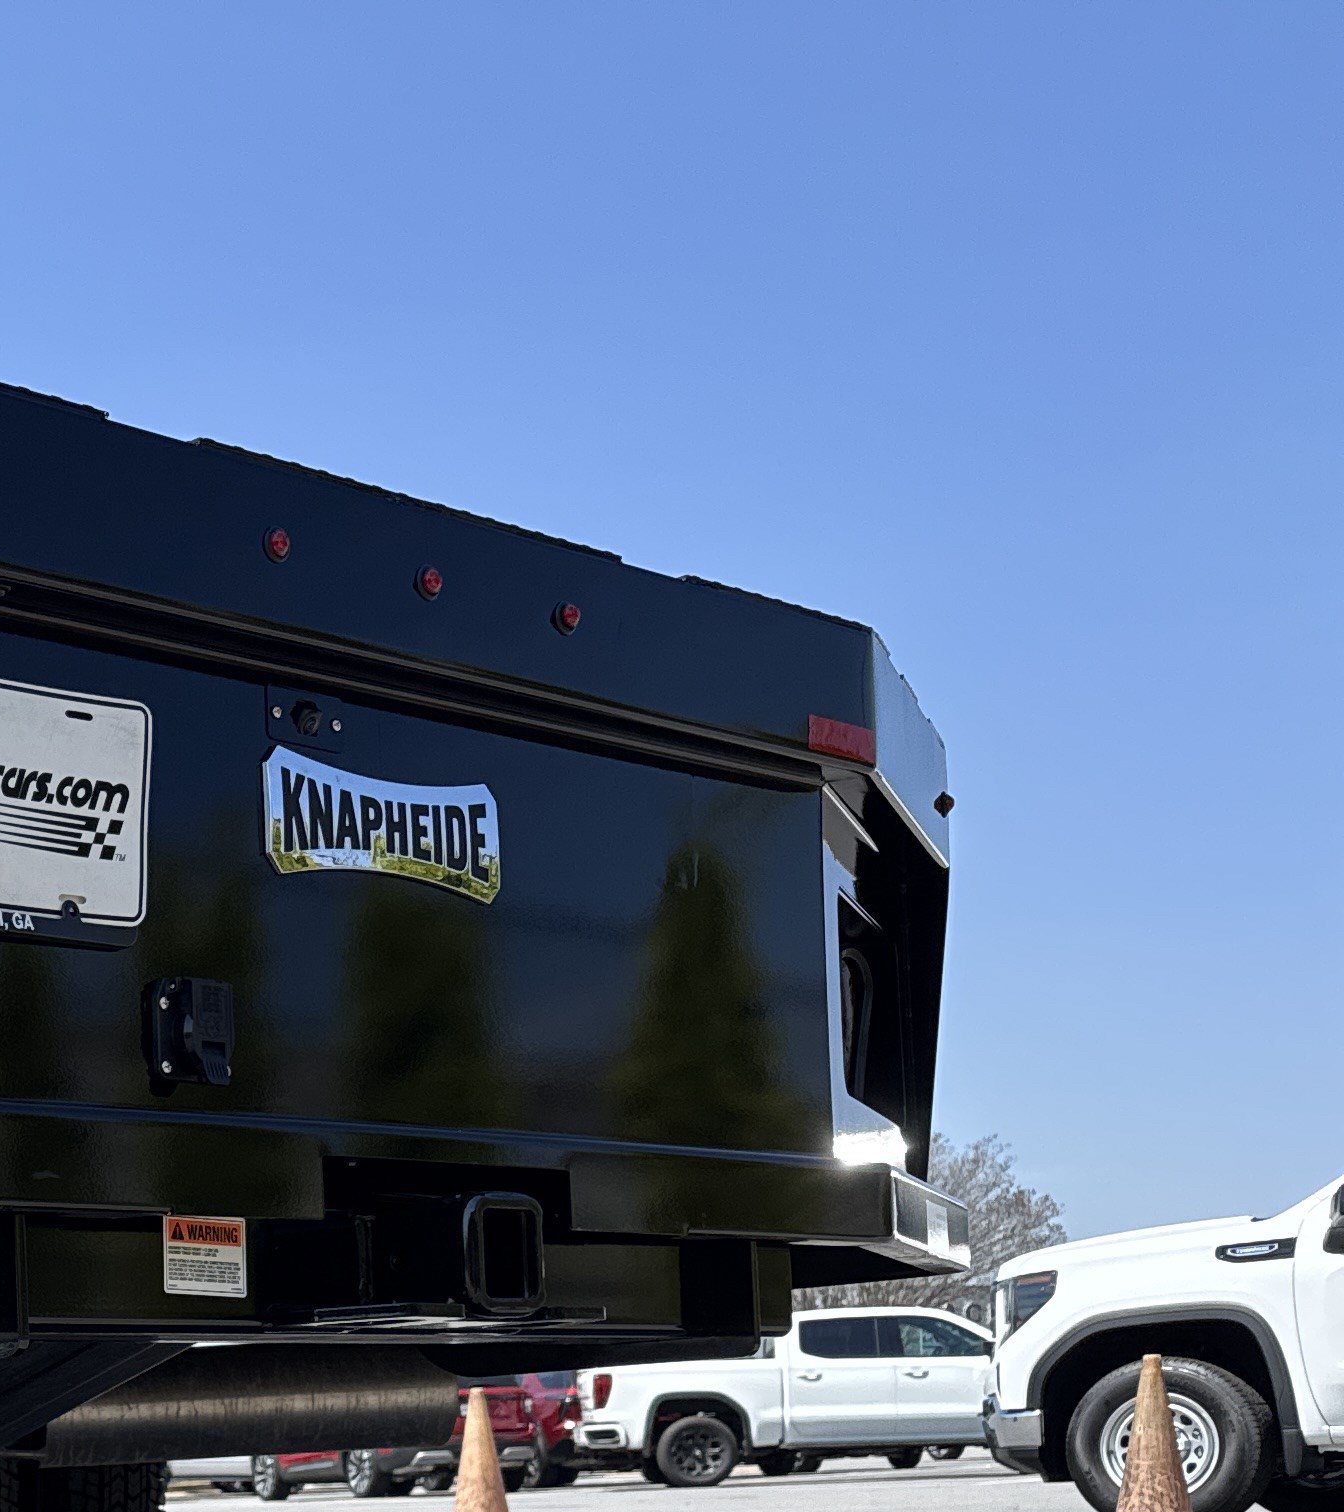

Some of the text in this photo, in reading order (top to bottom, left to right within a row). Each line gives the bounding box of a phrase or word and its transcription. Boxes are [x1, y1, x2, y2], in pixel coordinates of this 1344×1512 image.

[280, 766, 490, 884] KNAPHEIDE
[12, 911, 35, 931] GA
[187, 1224, 238, 1243] WARNING
